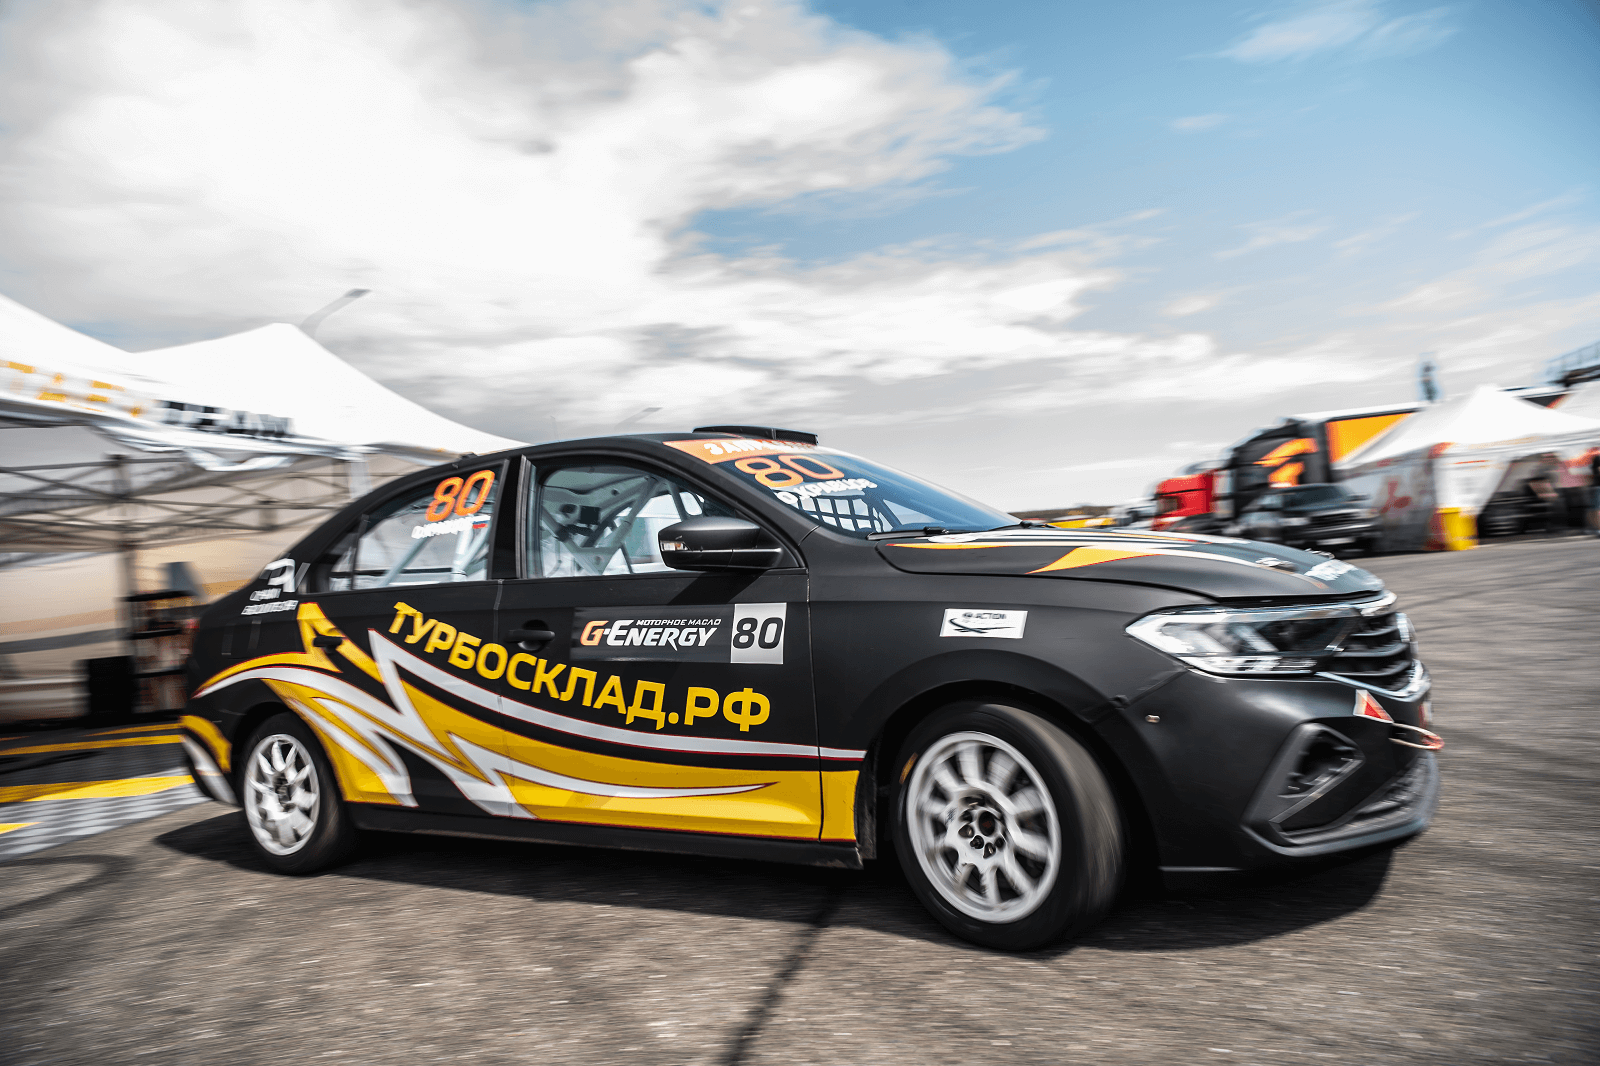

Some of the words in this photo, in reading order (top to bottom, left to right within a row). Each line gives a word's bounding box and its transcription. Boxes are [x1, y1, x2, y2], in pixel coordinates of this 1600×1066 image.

[735, 455, 844, 487] 80
[425, 470, 495, 522] 80
[635, 618, 686, 626] МОТОРНОЕ
[688, 618, 722, 626] МАСЛО
[733, 617, 783, 649] 80
[388, 601, 770, 732] ТУРБОСКЛАД.РФ
